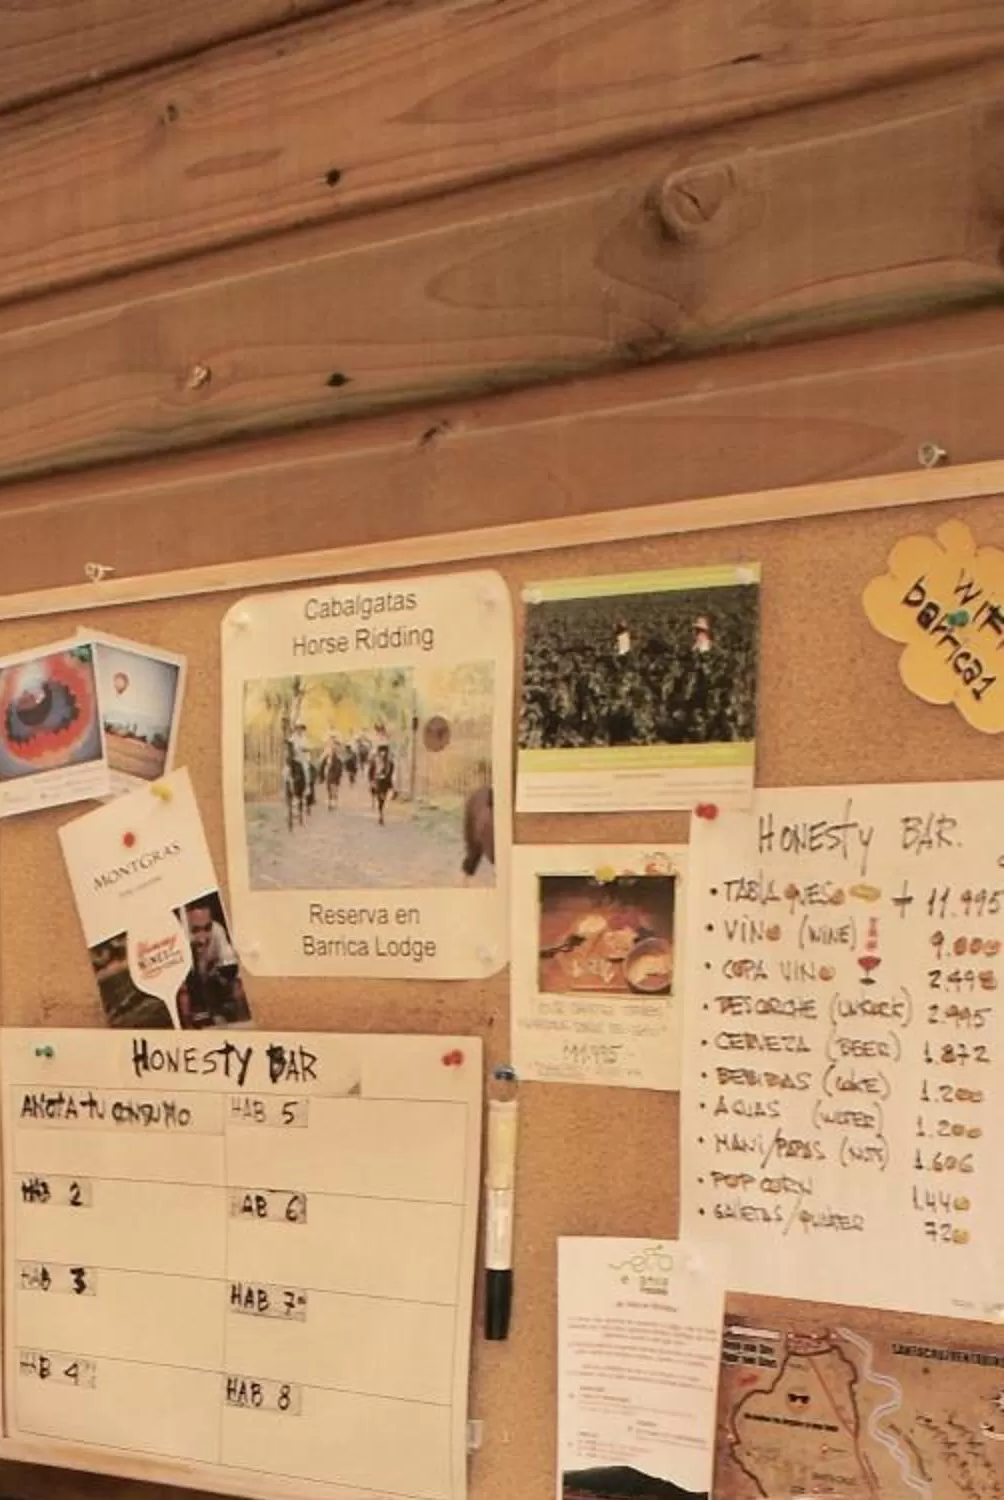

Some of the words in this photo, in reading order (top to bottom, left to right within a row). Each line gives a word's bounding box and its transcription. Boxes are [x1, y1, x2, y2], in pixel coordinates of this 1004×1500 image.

[303, 589, 418, 624] Cabalgatas
[954, 568, 1004, 649] WIF
[292, 627, 351, 658] Horse
[354, 622, 435, 655] Ridding
[759, 798, 874, 876] HONESTY
[308, 902, 389, 927] Reserva
[394, 906, 421, 927] en
[302, 933, 370, 958] Barrica
[374, 935, 437, 963] Lodge
[132, 1038, 253, 1085] HONESTY
[267, 1044, 319, 1084] BAR
[282, 1101, 299, 1125] 5
[69, 1180, 84, 1207] 2
[285, 1195, 300, 1221] 6
[70, 1267, 87, 1294] 3
[229, 1283, 267, 1311] HAB
[226, 1377, 263, 1407] HAB
[276, 1384, 292, 1411] 8
